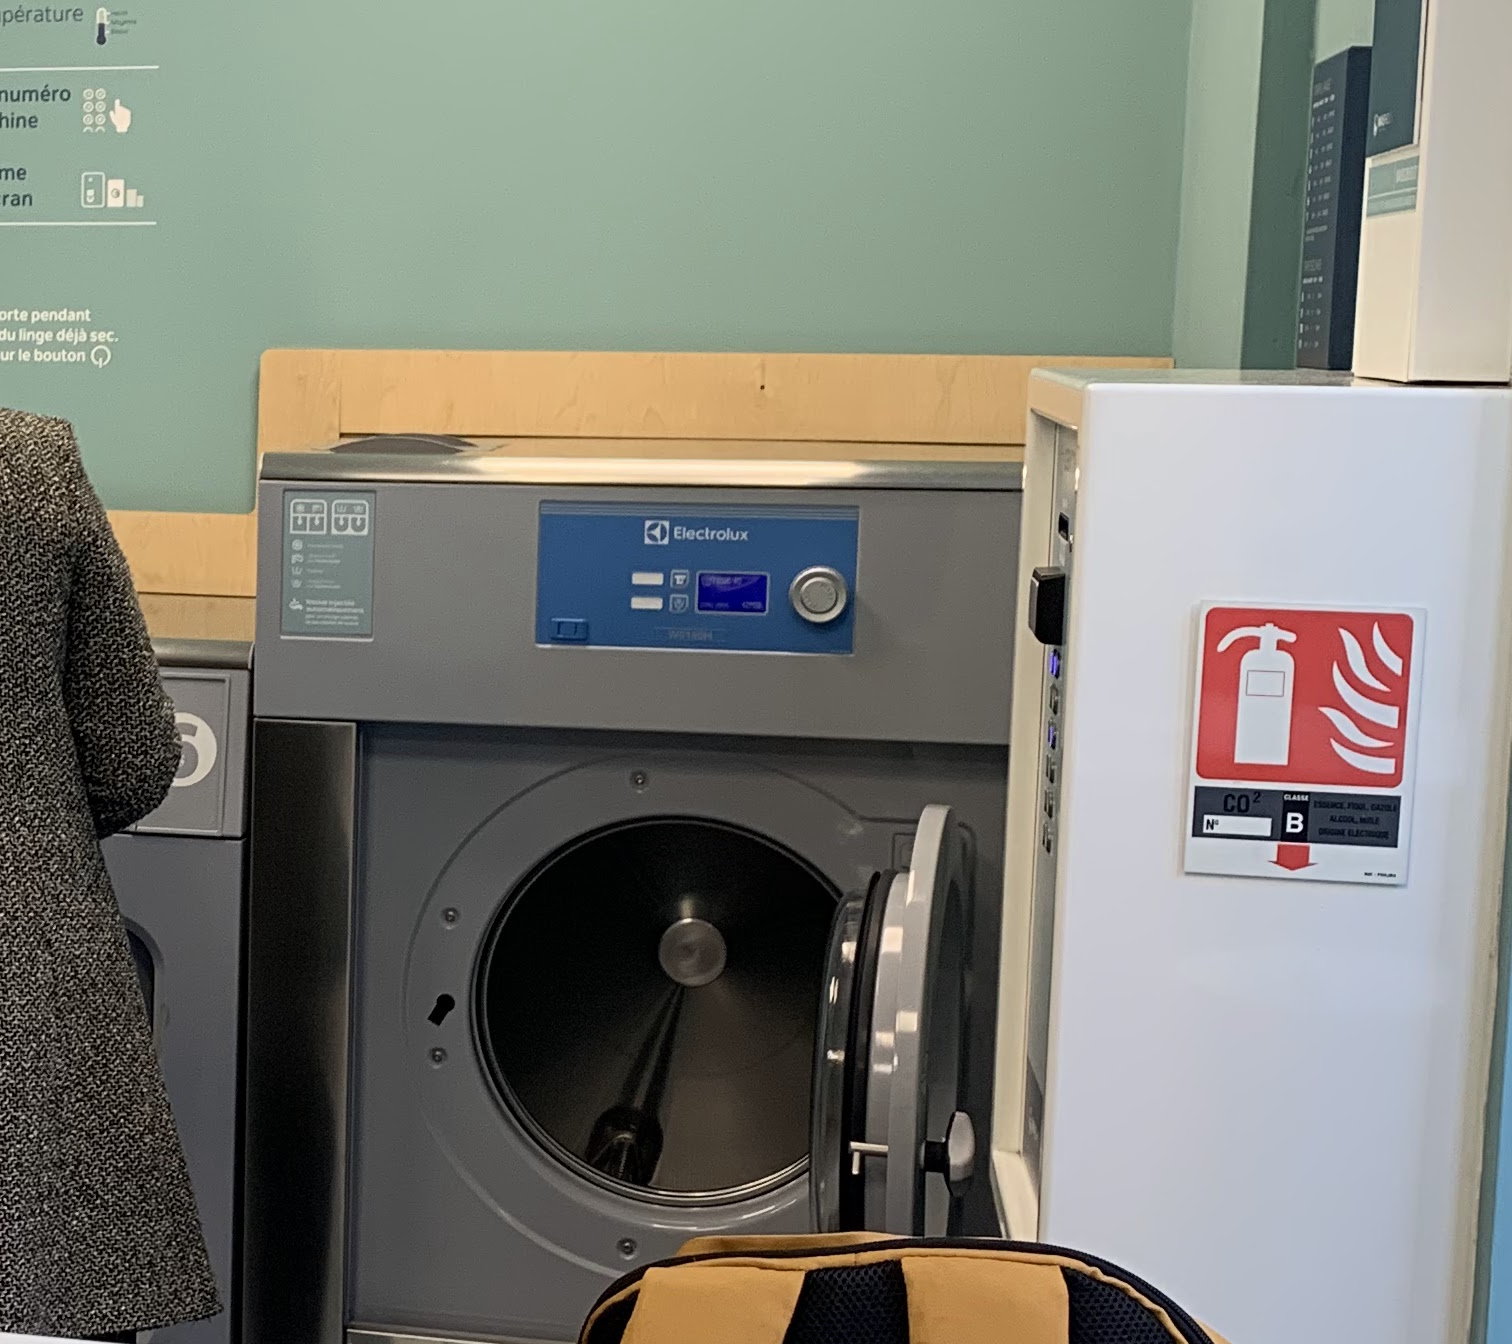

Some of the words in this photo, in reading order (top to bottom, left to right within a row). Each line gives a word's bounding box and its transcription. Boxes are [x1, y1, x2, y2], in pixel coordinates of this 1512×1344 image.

[31, 307, 92, 325] pendant
[18, 326, 54, 346] linge
[55, 326, 88, 346] déjà
[89, 330, 120, 343] sec.
[17, 348, 32, 363] le
[33, 348, 87, 363] bouton
[672, 525, 750, 542] Electrolux
[1282, 793, 1310, 802] CLASSE
[1285, 811, 1305, 834] B
